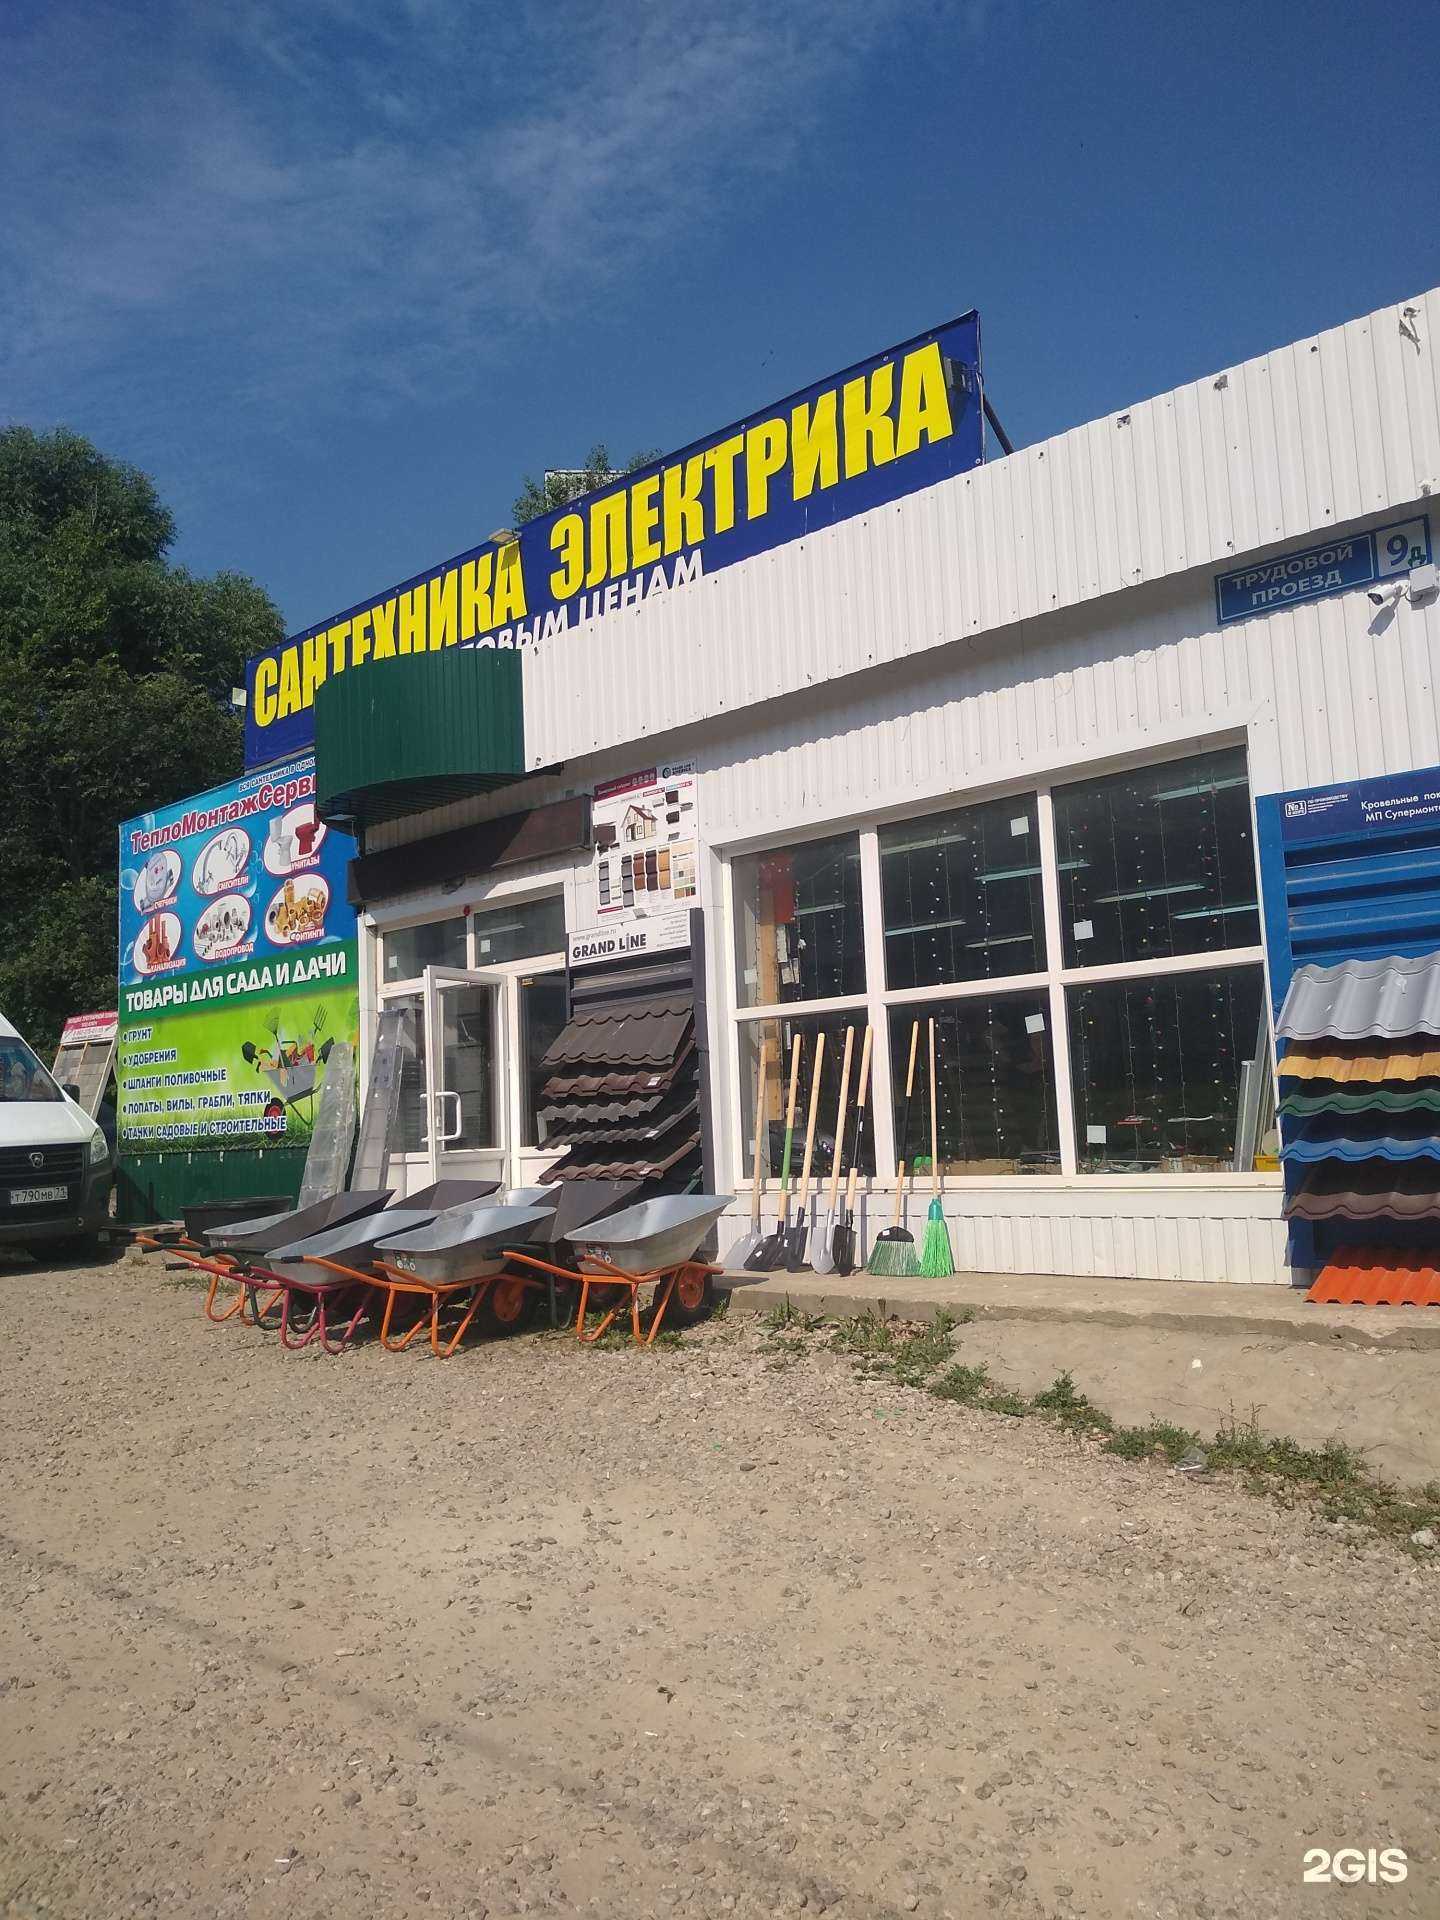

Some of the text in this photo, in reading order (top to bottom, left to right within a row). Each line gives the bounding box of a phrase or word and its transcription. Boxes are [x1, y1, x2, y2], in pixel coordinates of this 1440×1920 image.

[254, 341, 954, 728] САНТЕХНИКА ЭЛЕКТРИКА
[1232, 543, 1353, 590] ТРУДОВОЙ
[579, 548, 704, 625] ЦЕНАМ
[1252, 569, 1342, 606] ПРОЕЗД
[1361, 795, 1419, 811] Кровельные
[1365, 811, 1383, 822] МП
[215, 943, 254, 959] ВОДОПРОВОД
[573, 940, 616, 959] GRAND
[126, 951, 346, 1012] ТОВАРЫ ДЛЯ САДА И ДАЧИ
[128, 1028, 152, 1042] ГРУНТ
[128, 1049, 177, 1066] УДОБРЕНИЯ
[128, 1069, 226, 1089] ШЛАНГИ ПОЛИВОЧНЫЕ
[238, 1091, 271, 1105] ТЯПКИ
[128, 1116, 287, 1138] ТАЧКИ САДОВЫЕ И СТРОИТЕЛЬНЫЕ
